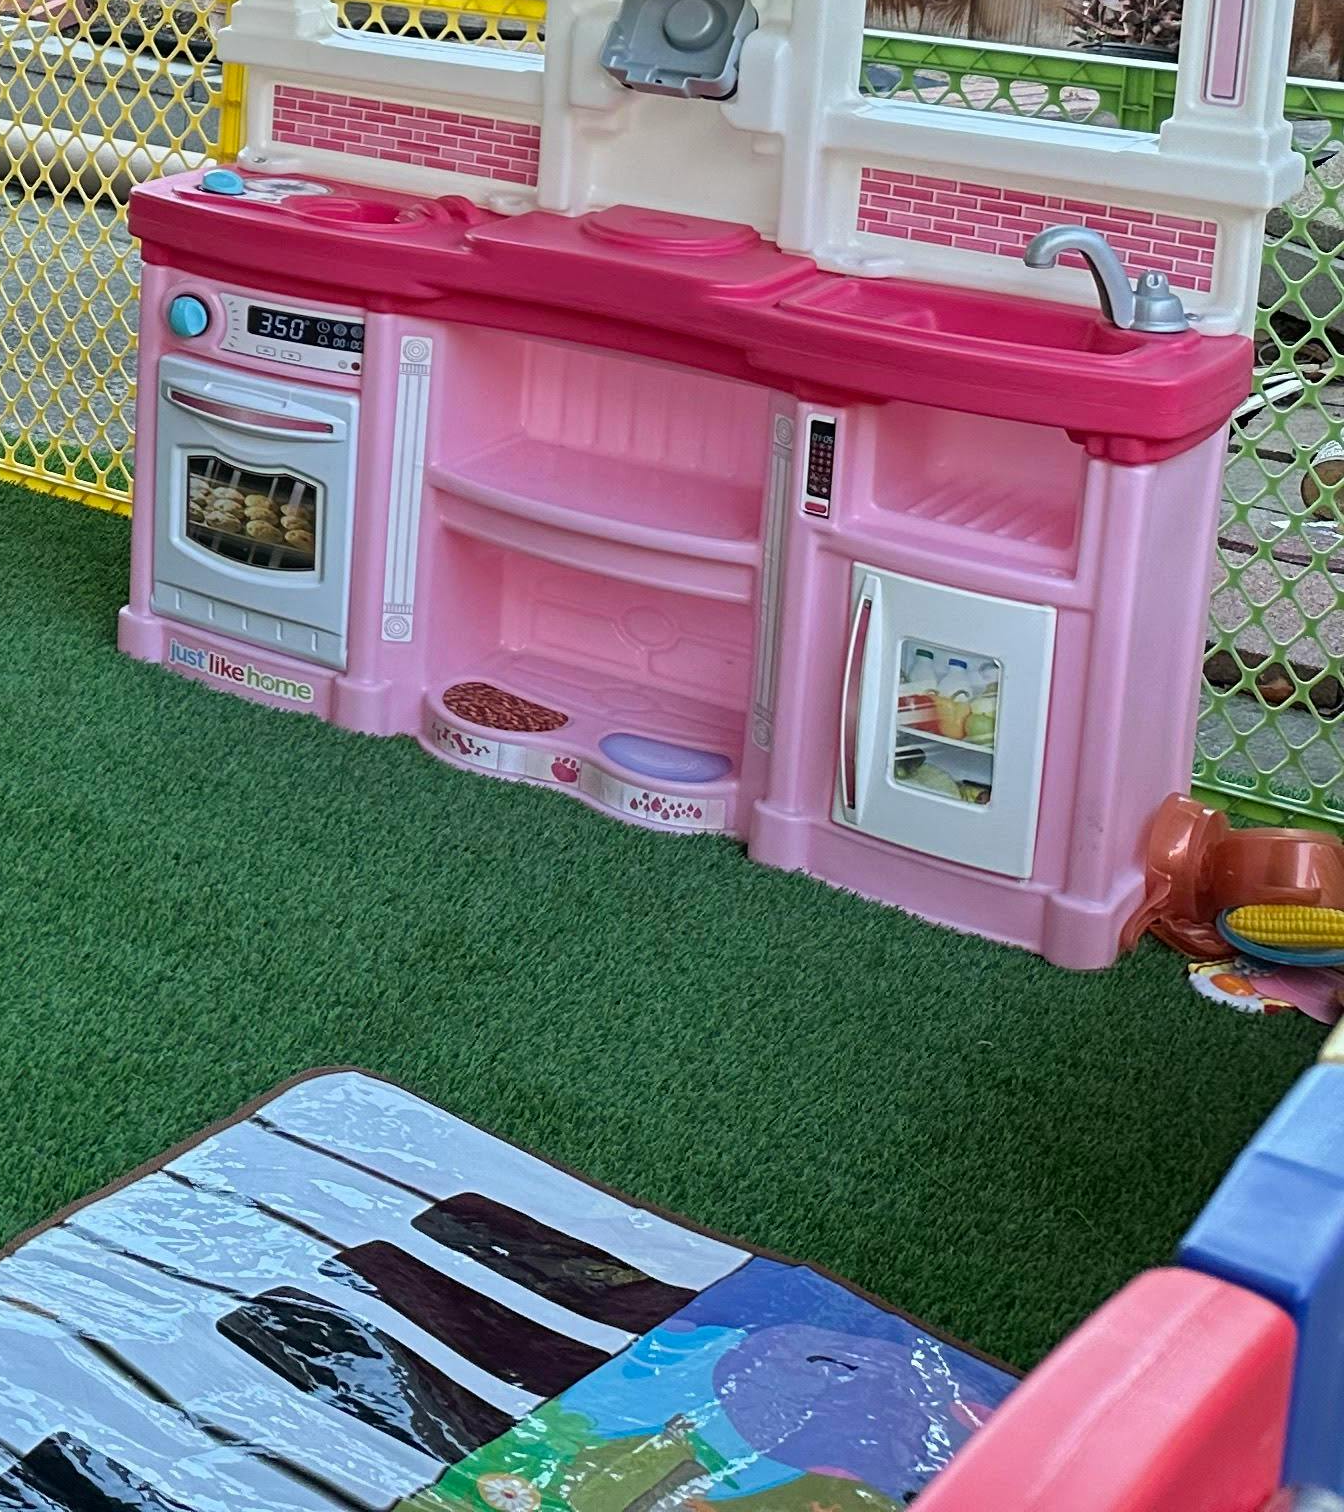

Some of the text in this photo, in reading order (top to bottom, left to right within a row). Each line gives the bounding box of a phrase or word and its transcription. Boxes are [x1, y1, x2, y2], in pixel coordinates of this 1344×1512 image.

[169, 640, 312, 701] just like home
